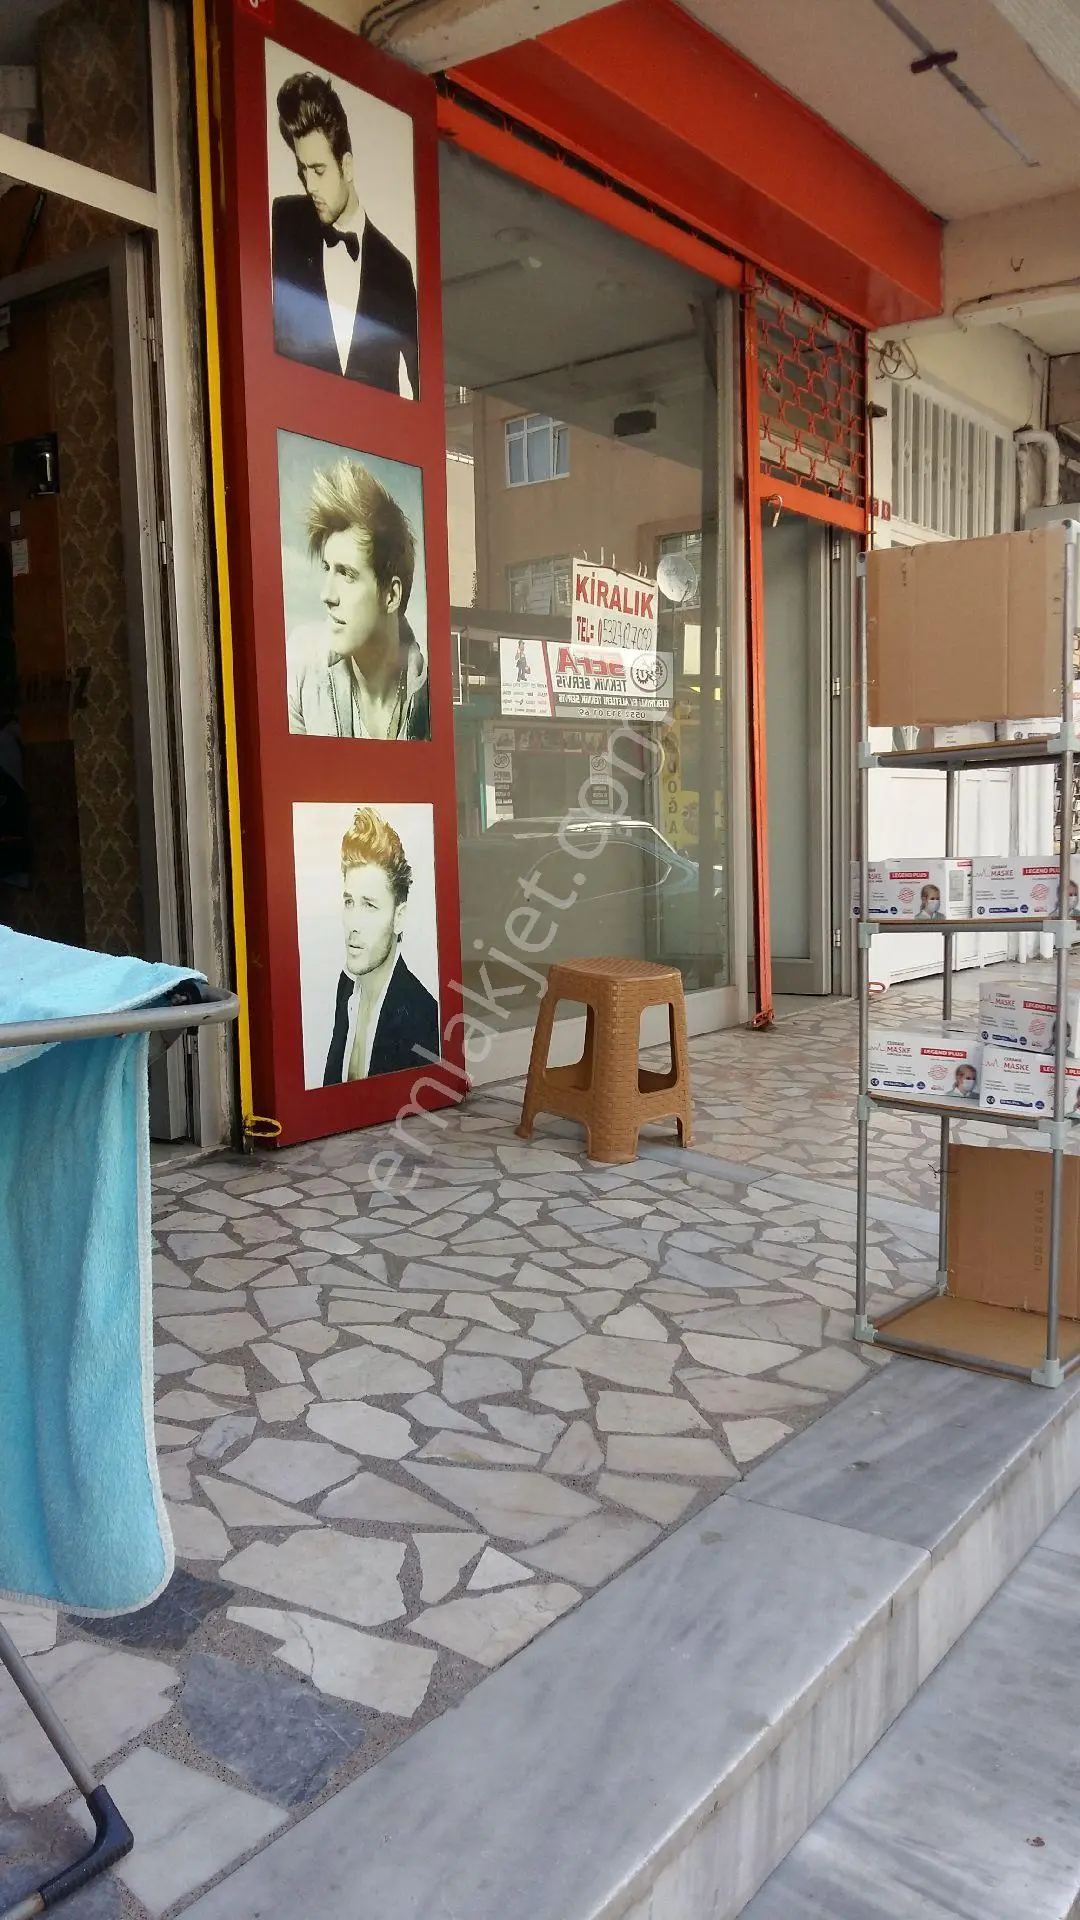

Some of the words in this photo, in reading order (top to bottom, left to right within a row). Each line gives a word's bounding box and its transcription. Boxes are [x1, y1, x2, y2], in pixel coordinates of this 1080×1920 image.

[575, 571, 655, 620] KİRALIK
[576, 615, 595, 644] TEL:
[990, 869, 1014, 878] MASKE
[886, 1046, 912, 1054] MASKE
[1003, 1062, 1031, 1071] MASKE
